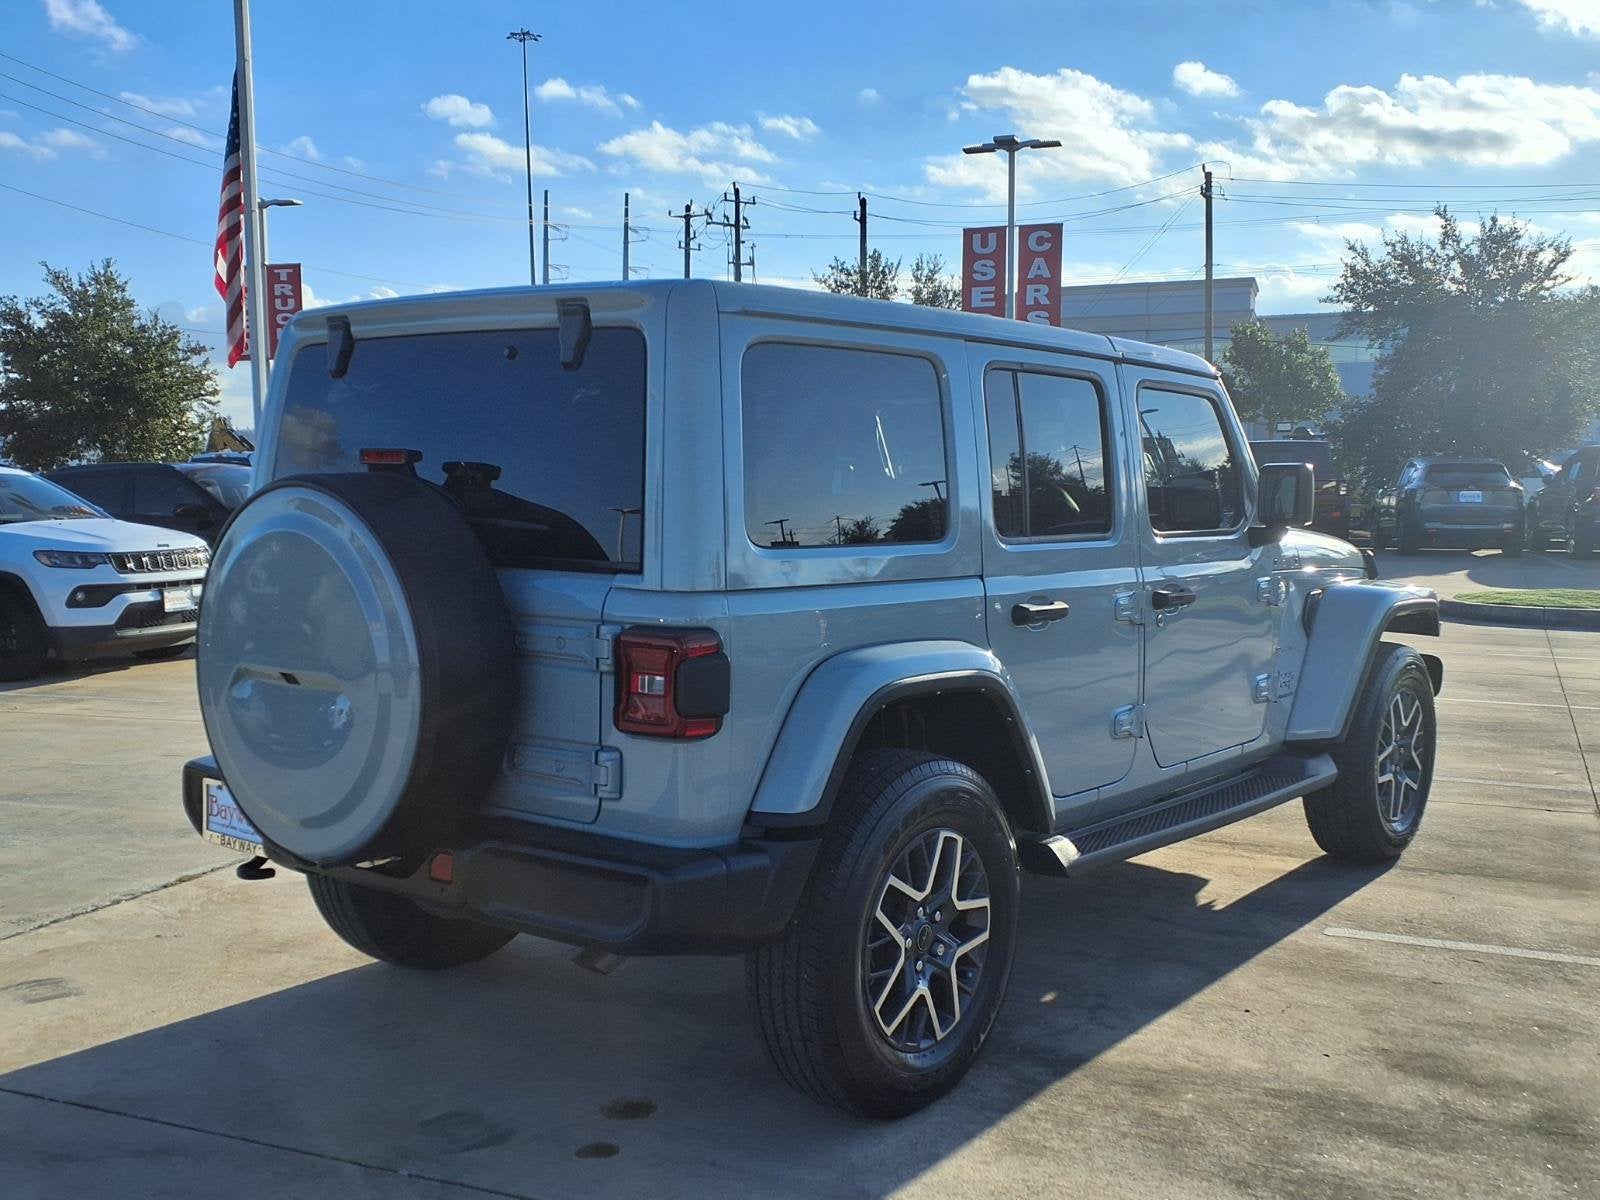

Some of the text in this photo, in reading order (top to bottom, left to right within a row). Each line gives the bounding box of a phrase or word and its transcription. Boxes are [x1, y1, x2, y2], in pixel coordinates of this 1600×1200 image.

[274, 269, 296, 340] TRUC
[972, 232, 997, 313] USE
[1026, 230, 1052, 326] CARS
[220, 835, 257, 854] BAYWAY
